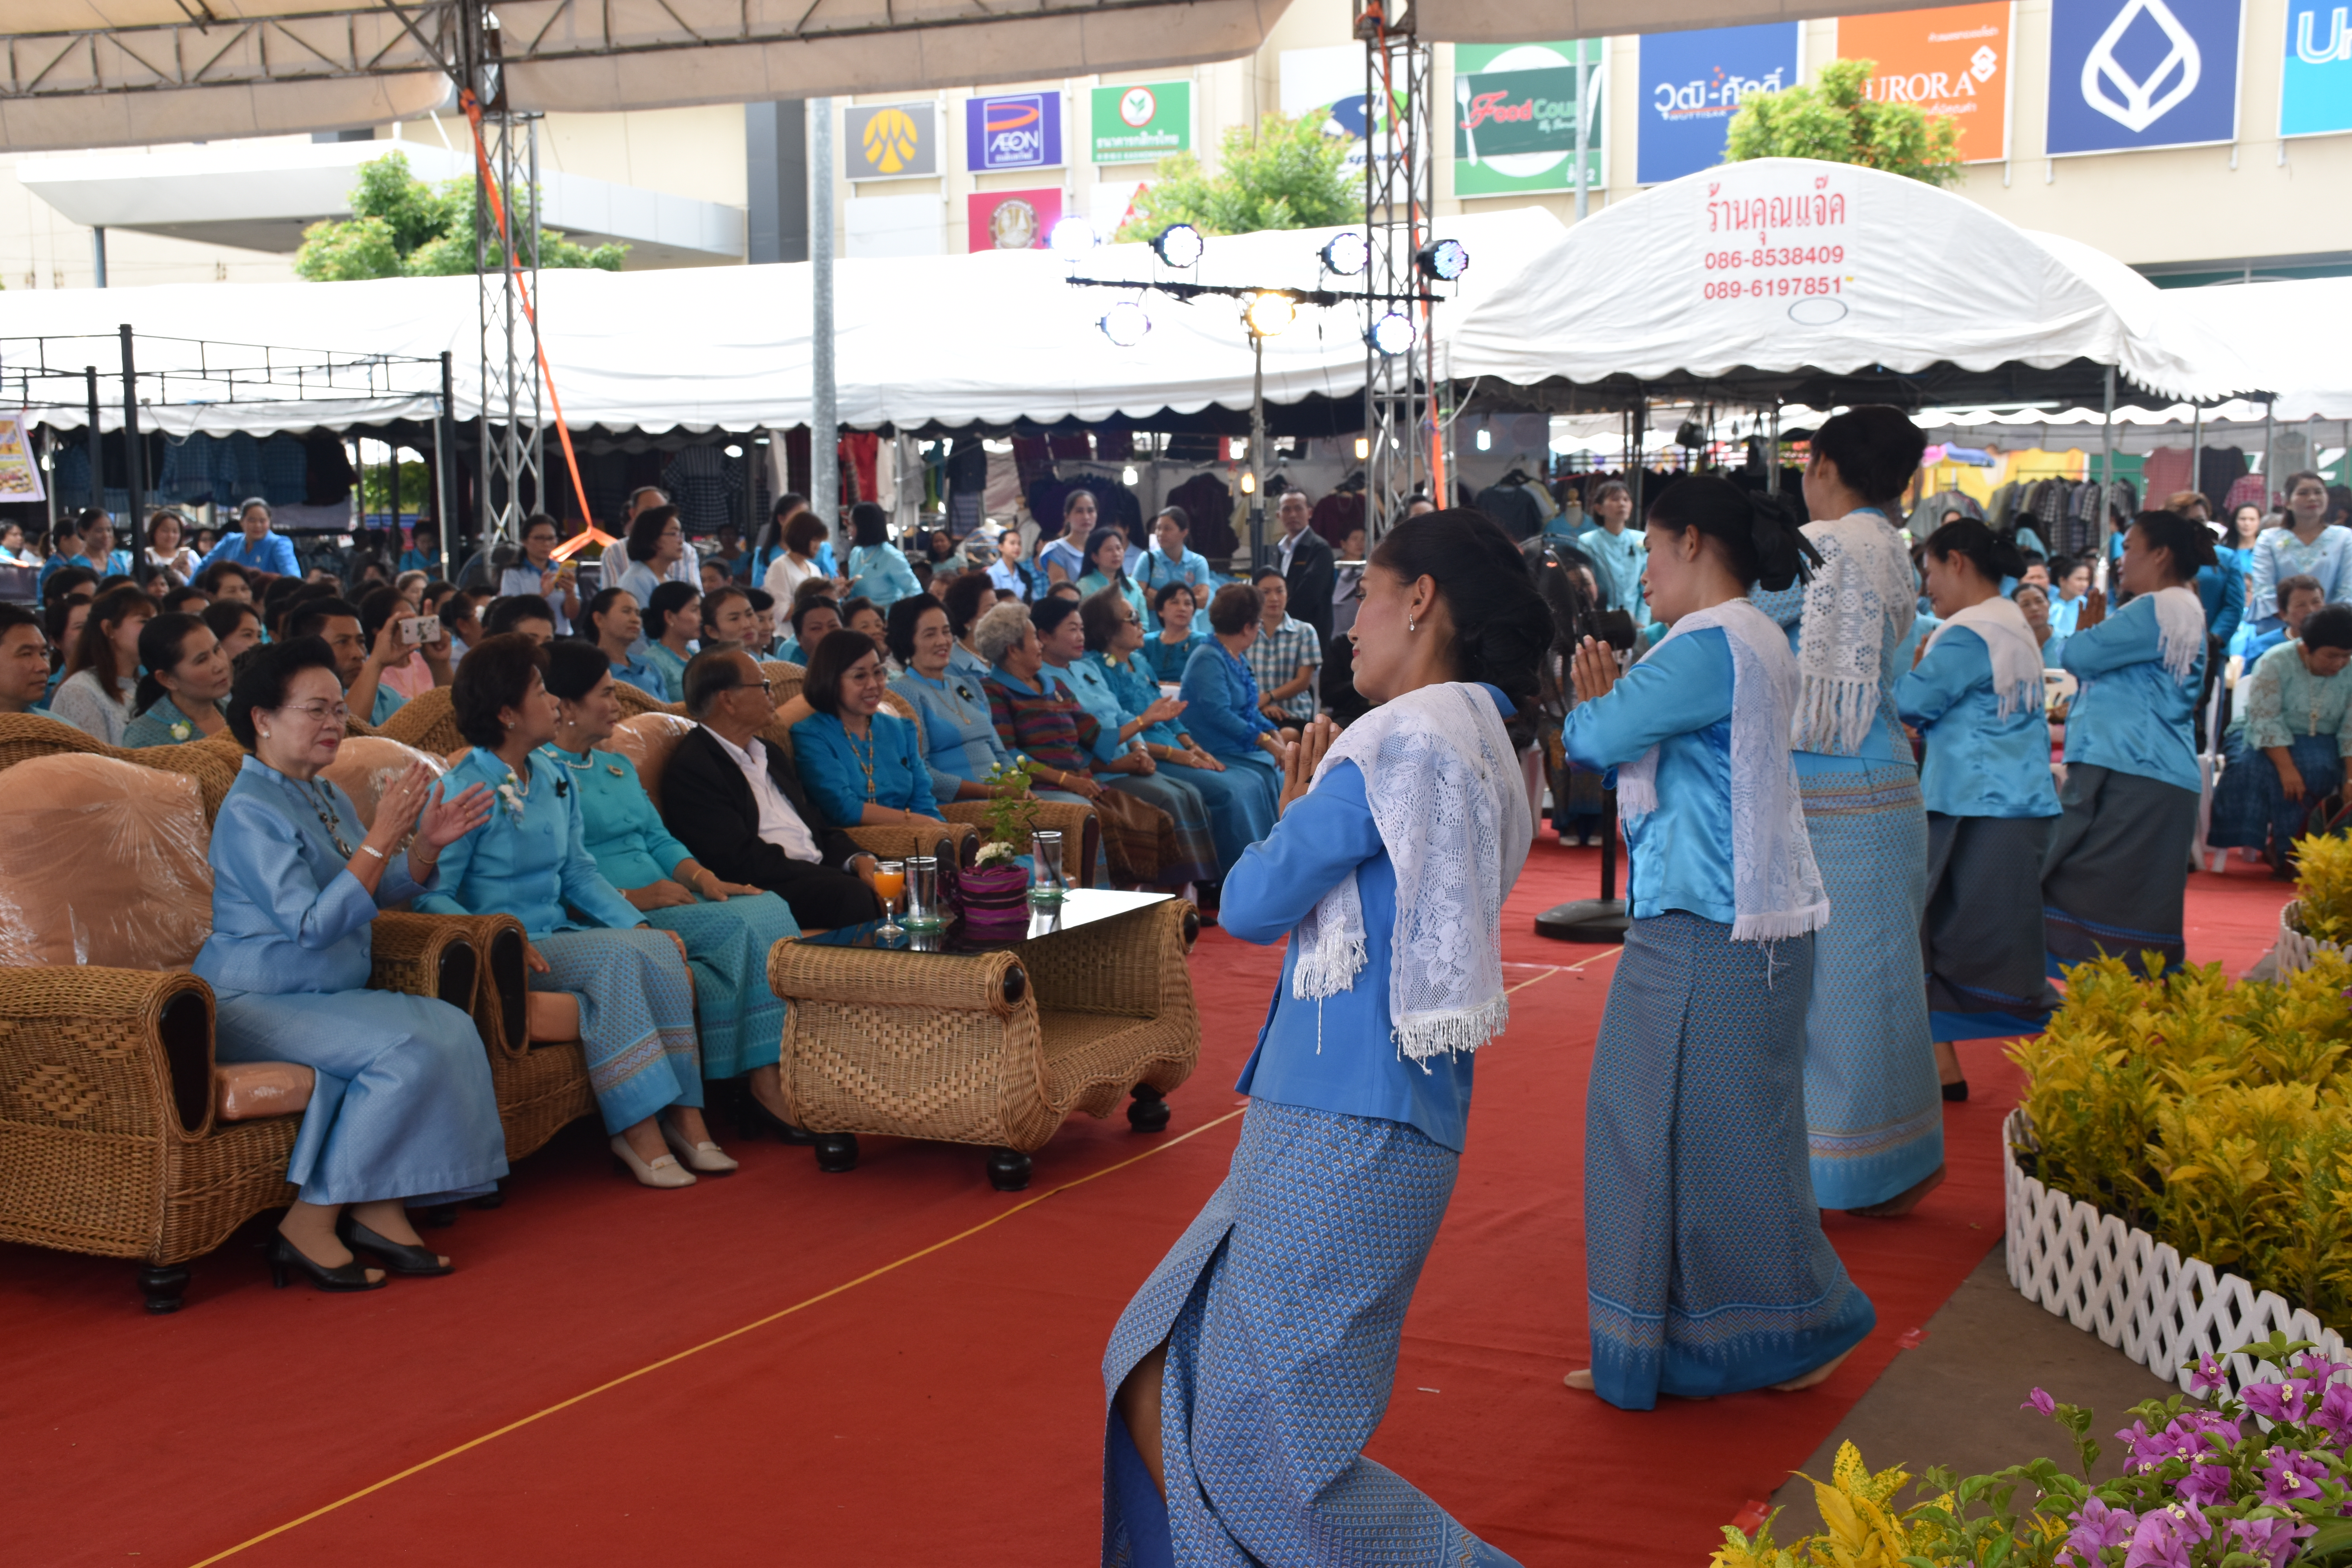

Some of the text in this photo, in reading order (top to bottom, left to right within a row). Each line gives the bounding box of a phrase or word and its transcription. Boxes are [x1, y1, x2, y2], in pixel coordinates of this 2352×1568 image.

[1864, 70, 1976, 103] URORA
[1459, 89, 1533, 130] Food
[1707, 174, 1845, 246] ร้านคุณแจ๊ค
[1705, 245, 1844, 270] 086-8538409
[1704, 276, 1842, 300] 089-6197851
